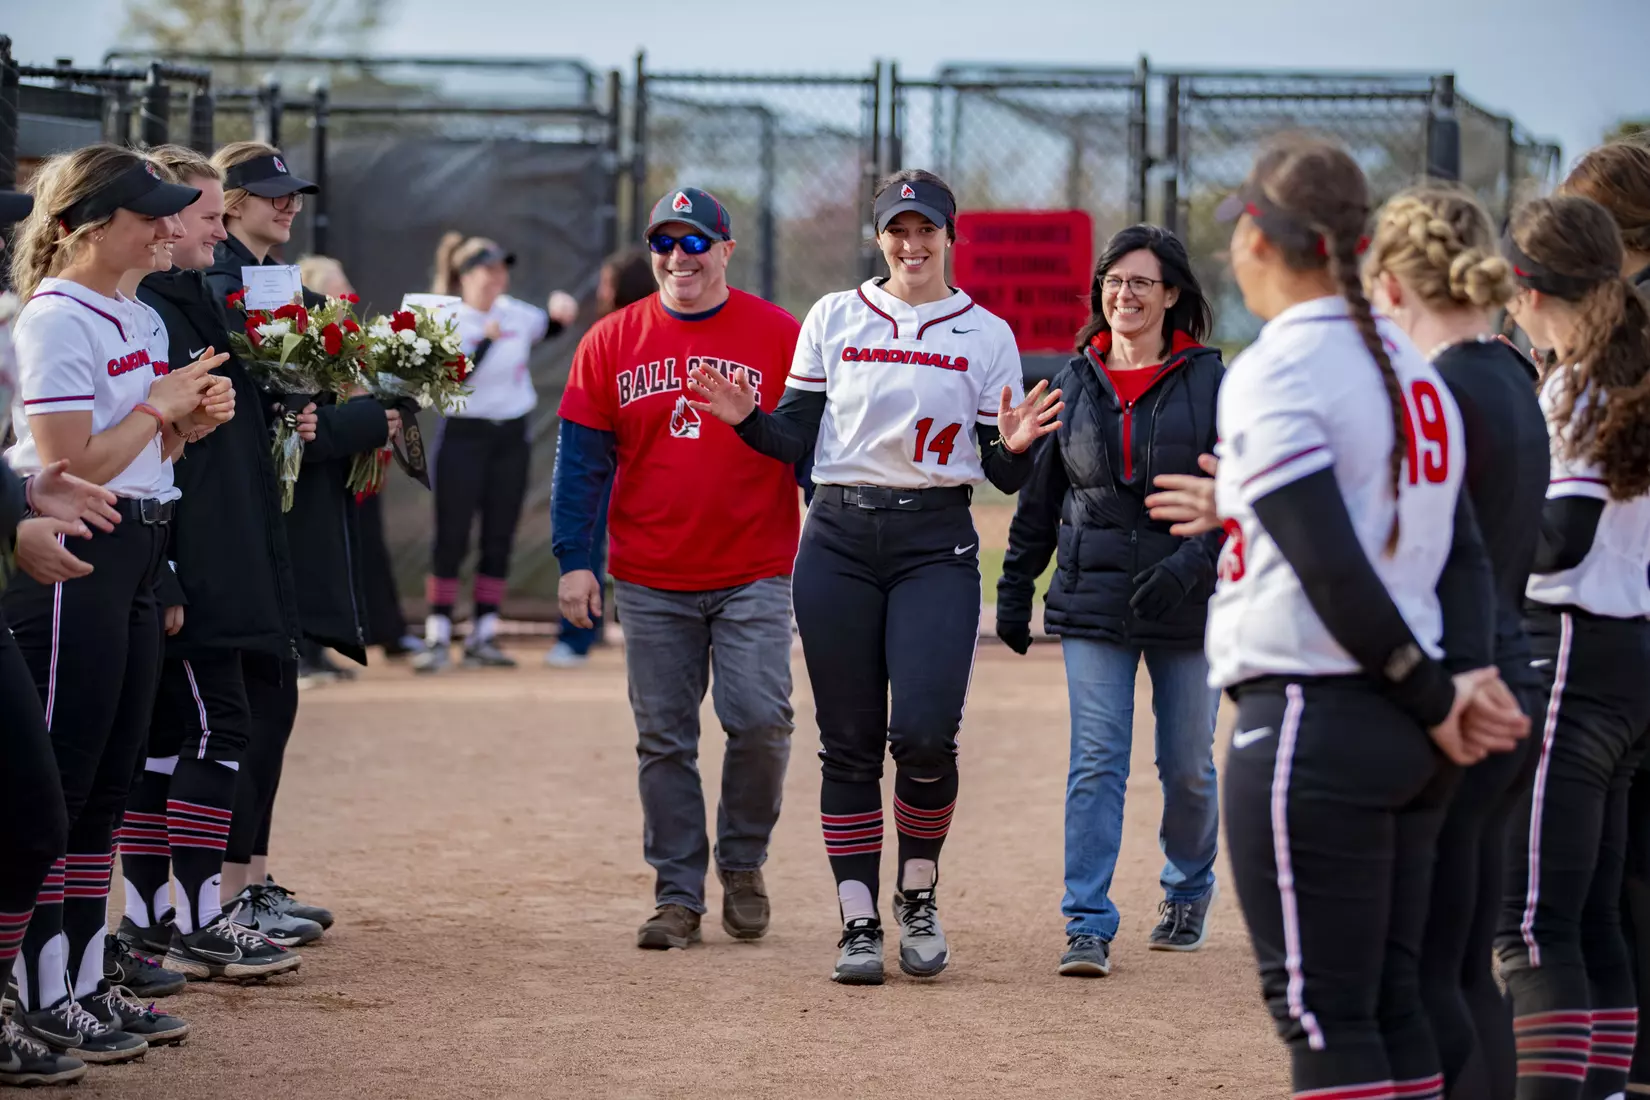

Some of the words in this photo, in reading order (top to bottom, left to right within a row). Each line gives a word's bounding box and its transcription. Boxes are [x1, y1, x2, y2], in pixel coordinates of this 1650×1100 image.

[617, 357, 682, 408] BALL
[841, 346, 969, 372] CARDINALS
[913, 417, 962, 465] 14
